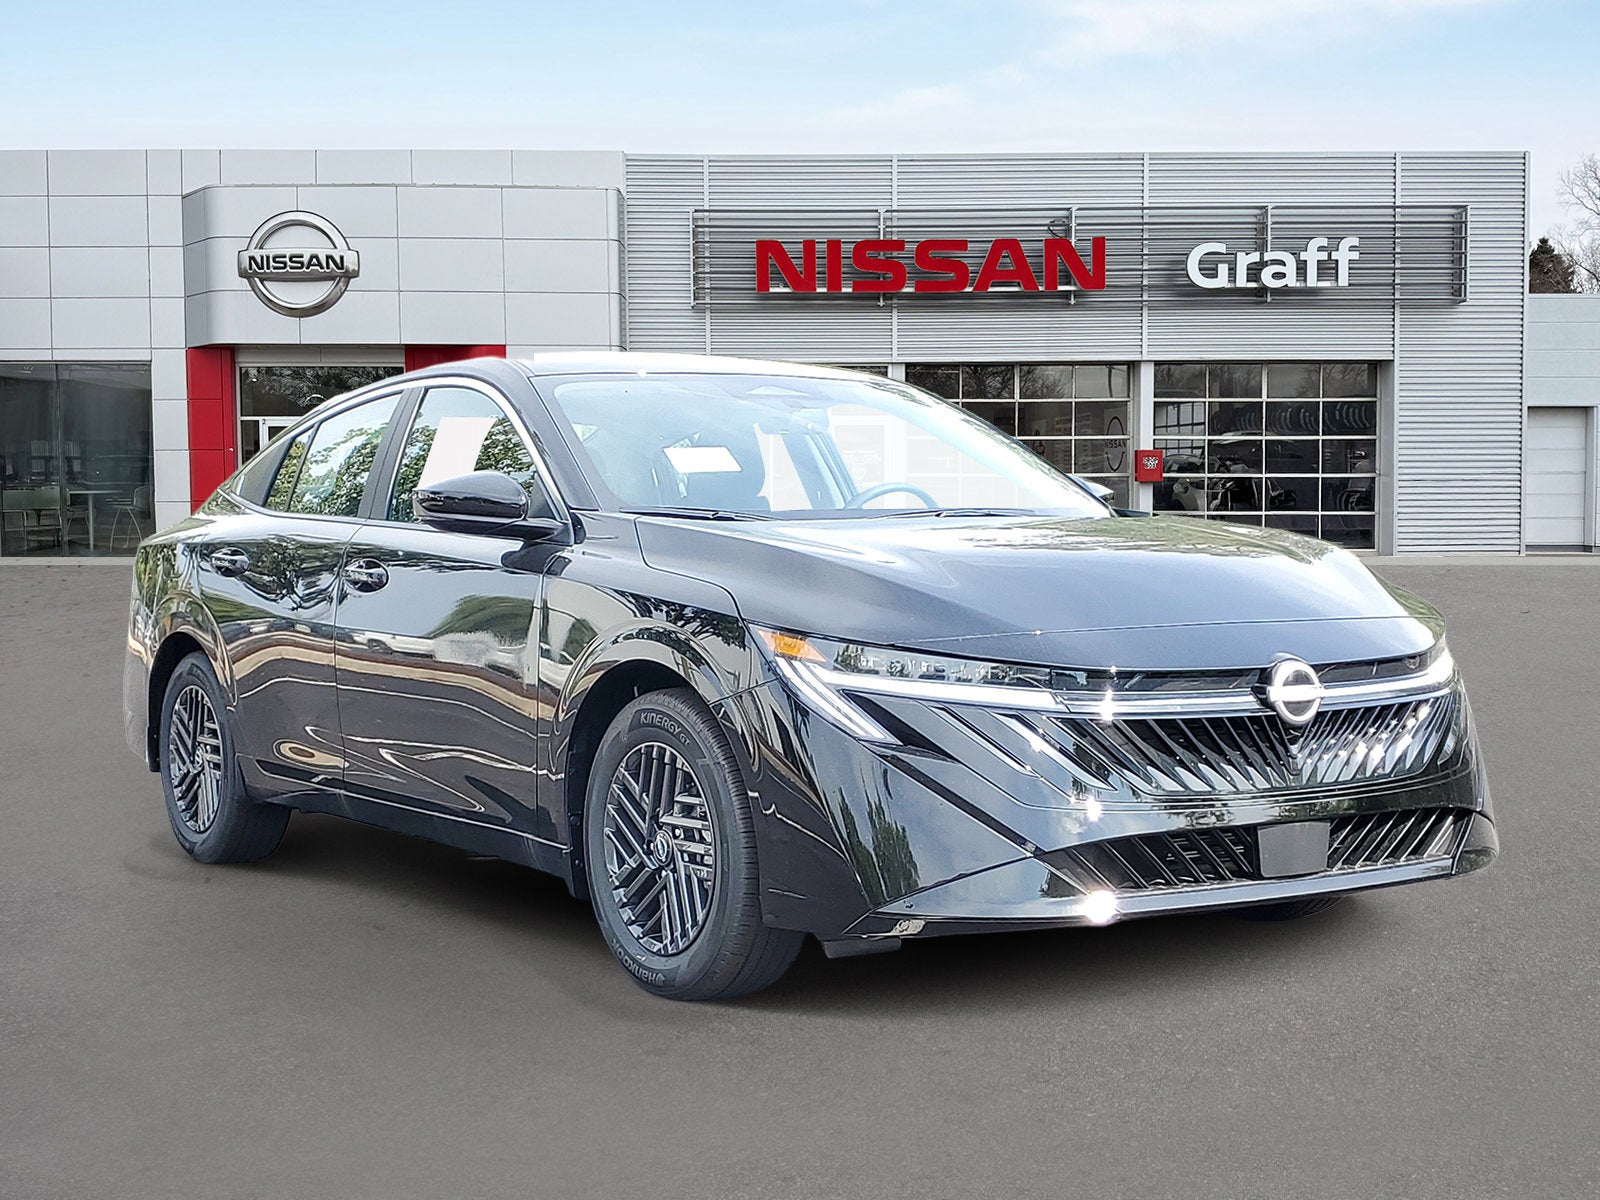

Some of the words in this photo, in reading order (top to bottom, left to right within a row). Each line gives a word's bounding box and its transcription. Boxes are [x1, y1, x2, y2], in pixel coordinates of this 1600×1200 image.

[248, 254, 345, 271] NISSAN
[755, 237, 1107, 293] NISSAN
[1186, 237, 1361, 289] Graff
[640, 712, 682, 735] KINERGY
[679, 733, 691, 746] GT
